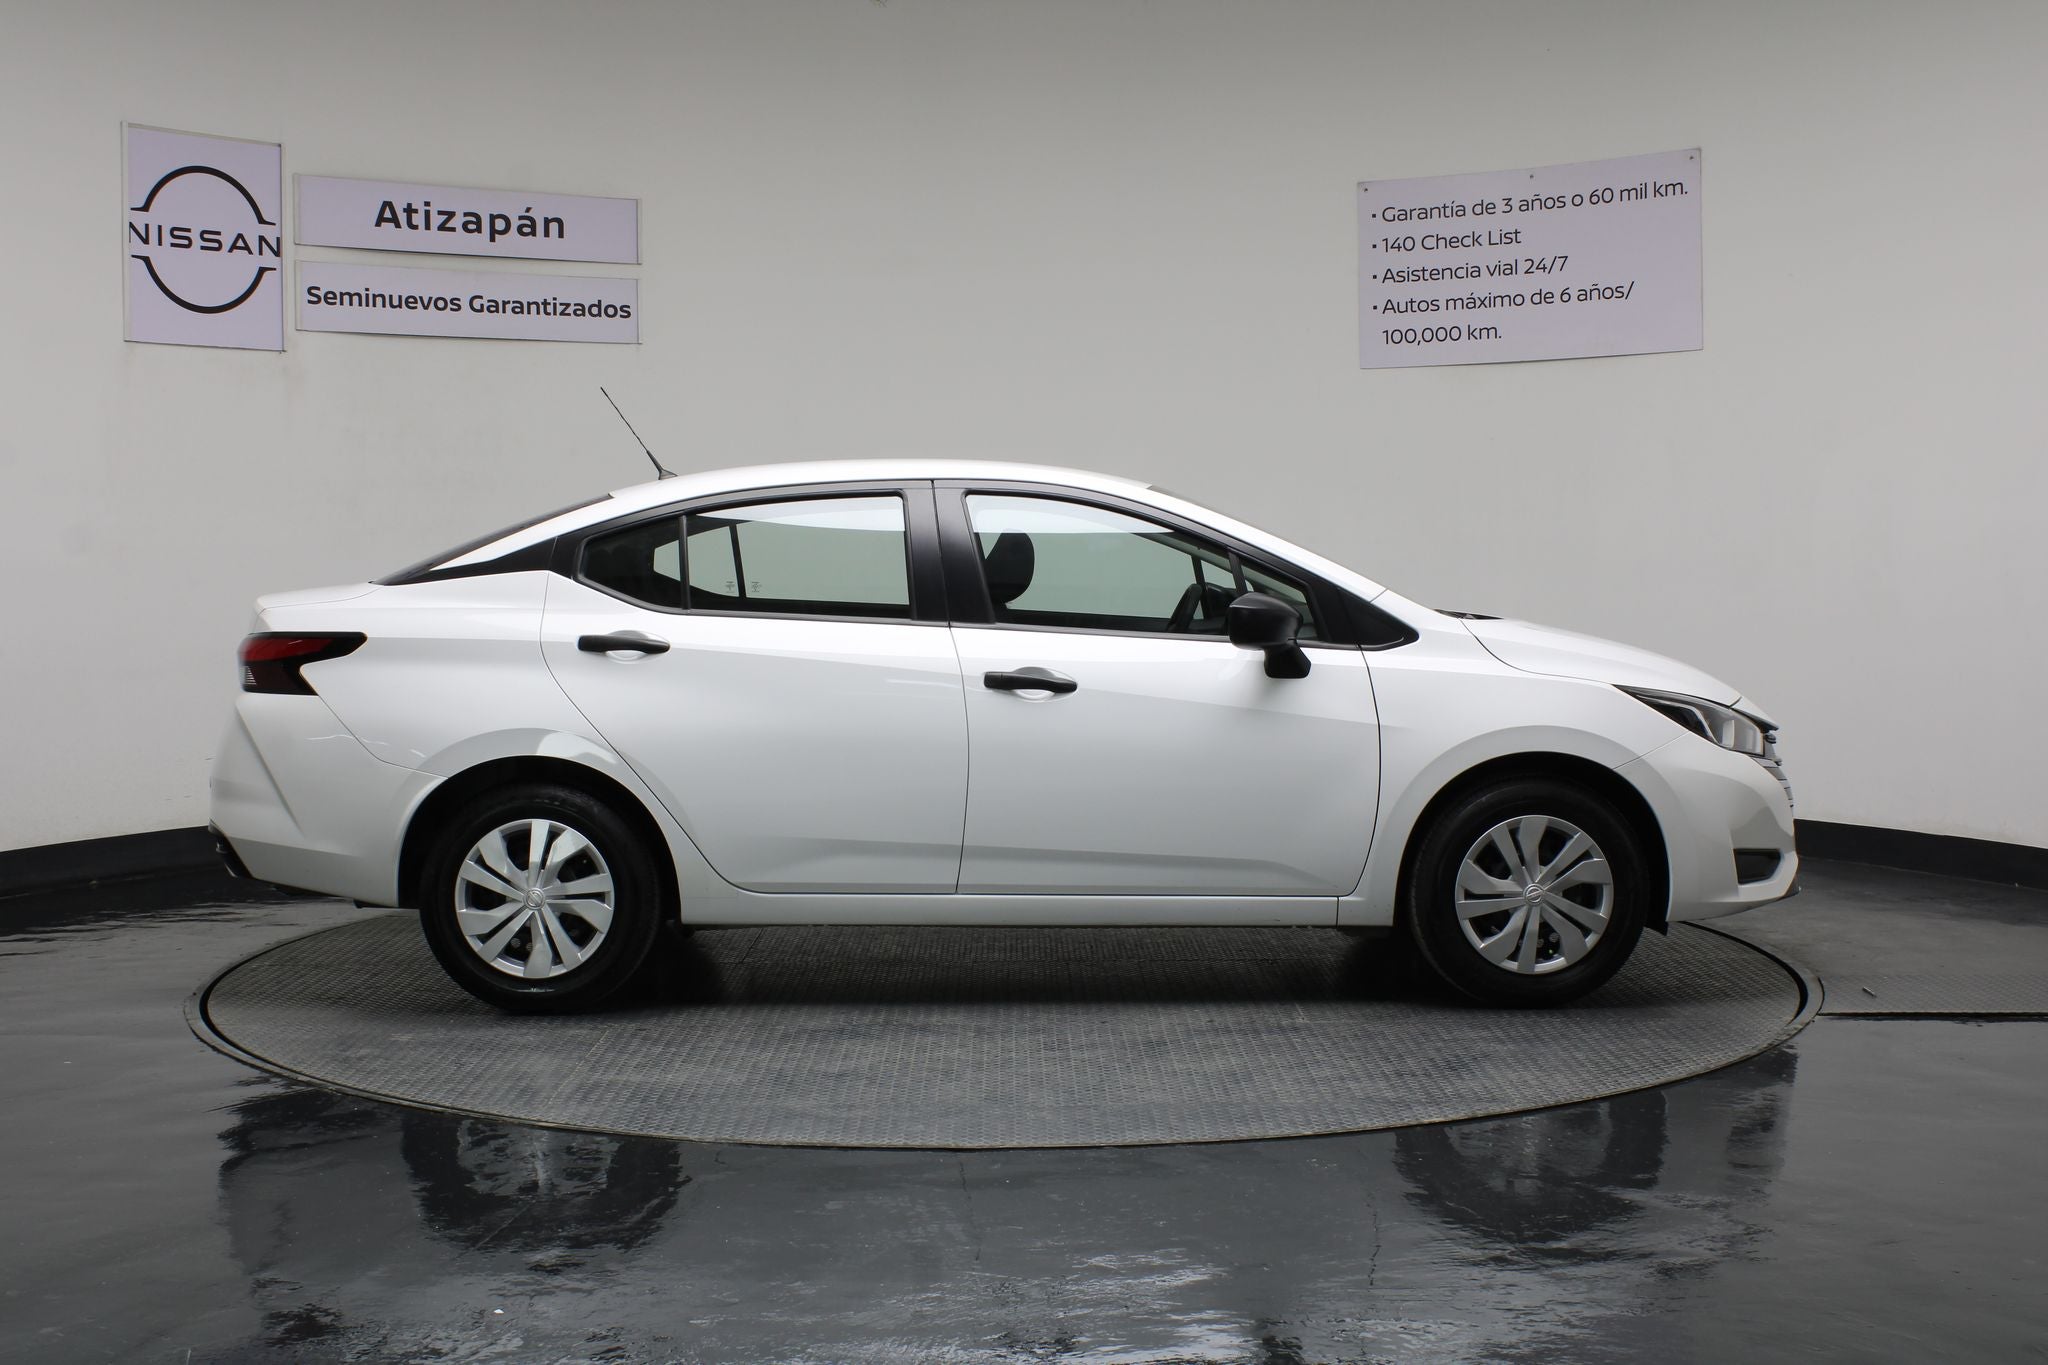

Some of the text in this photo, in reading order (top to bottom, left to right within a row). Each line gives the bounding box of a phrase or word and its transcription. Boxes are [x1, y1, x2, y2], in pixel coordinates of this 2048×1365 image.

[1381, 180, 1689, 223] Garantía de 3 años o 60 mil km.
[374, 200, 565, 243] Atizapán
[128, 221, 282, 258] NISSAN
[1381, 228, 1522, 254] 140 Check List
[1381, 255, 1569, 284] Asistencia vial 24/7
[306, 285, 632, 319] Seminuevos Garantizados
[1381, 280, 1635, 315] Autos máximo de 6 años/
[1381, 323, 1502, 347] 100,000 km.
